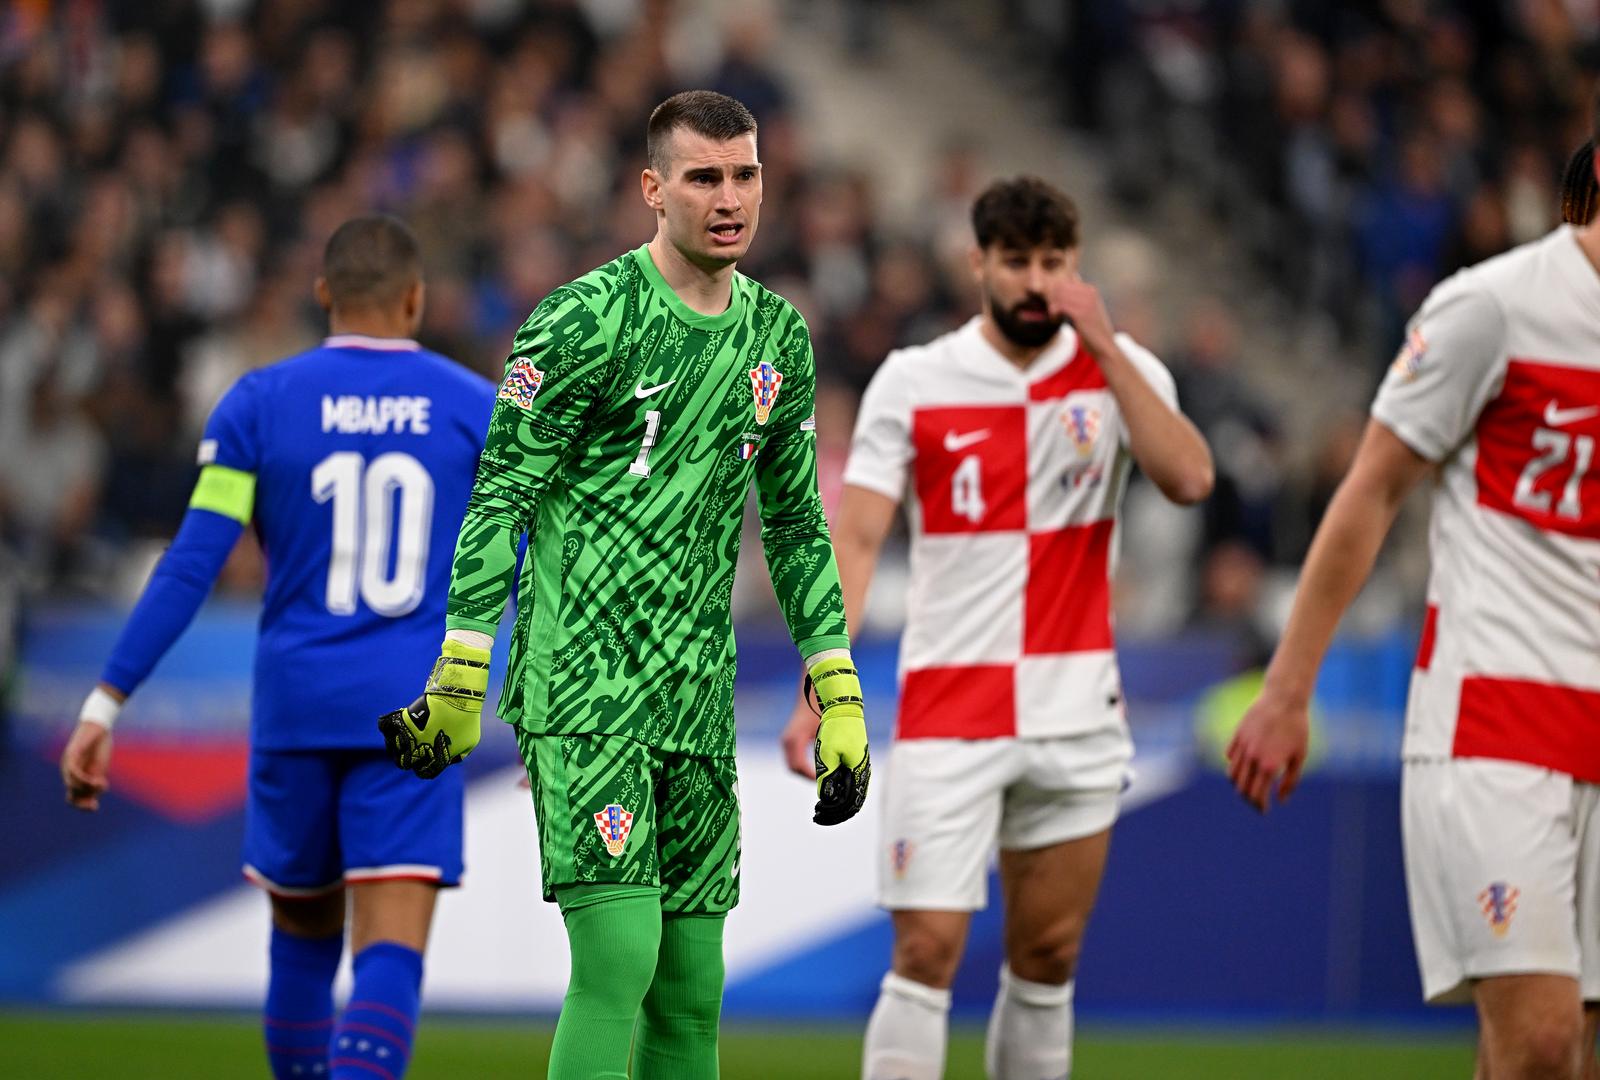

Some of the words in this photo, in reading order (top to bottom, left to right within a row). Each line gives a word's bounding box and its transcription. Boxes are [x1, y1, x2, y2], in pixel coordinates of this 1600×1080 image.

[320, 394, 431, 435] MBAPPE
[629, 410, 661, 479] 1
[952, 454, 986, 525] 4
[1513, 427, 1595, 522] 21
[311, 451, 435, 618] 10
